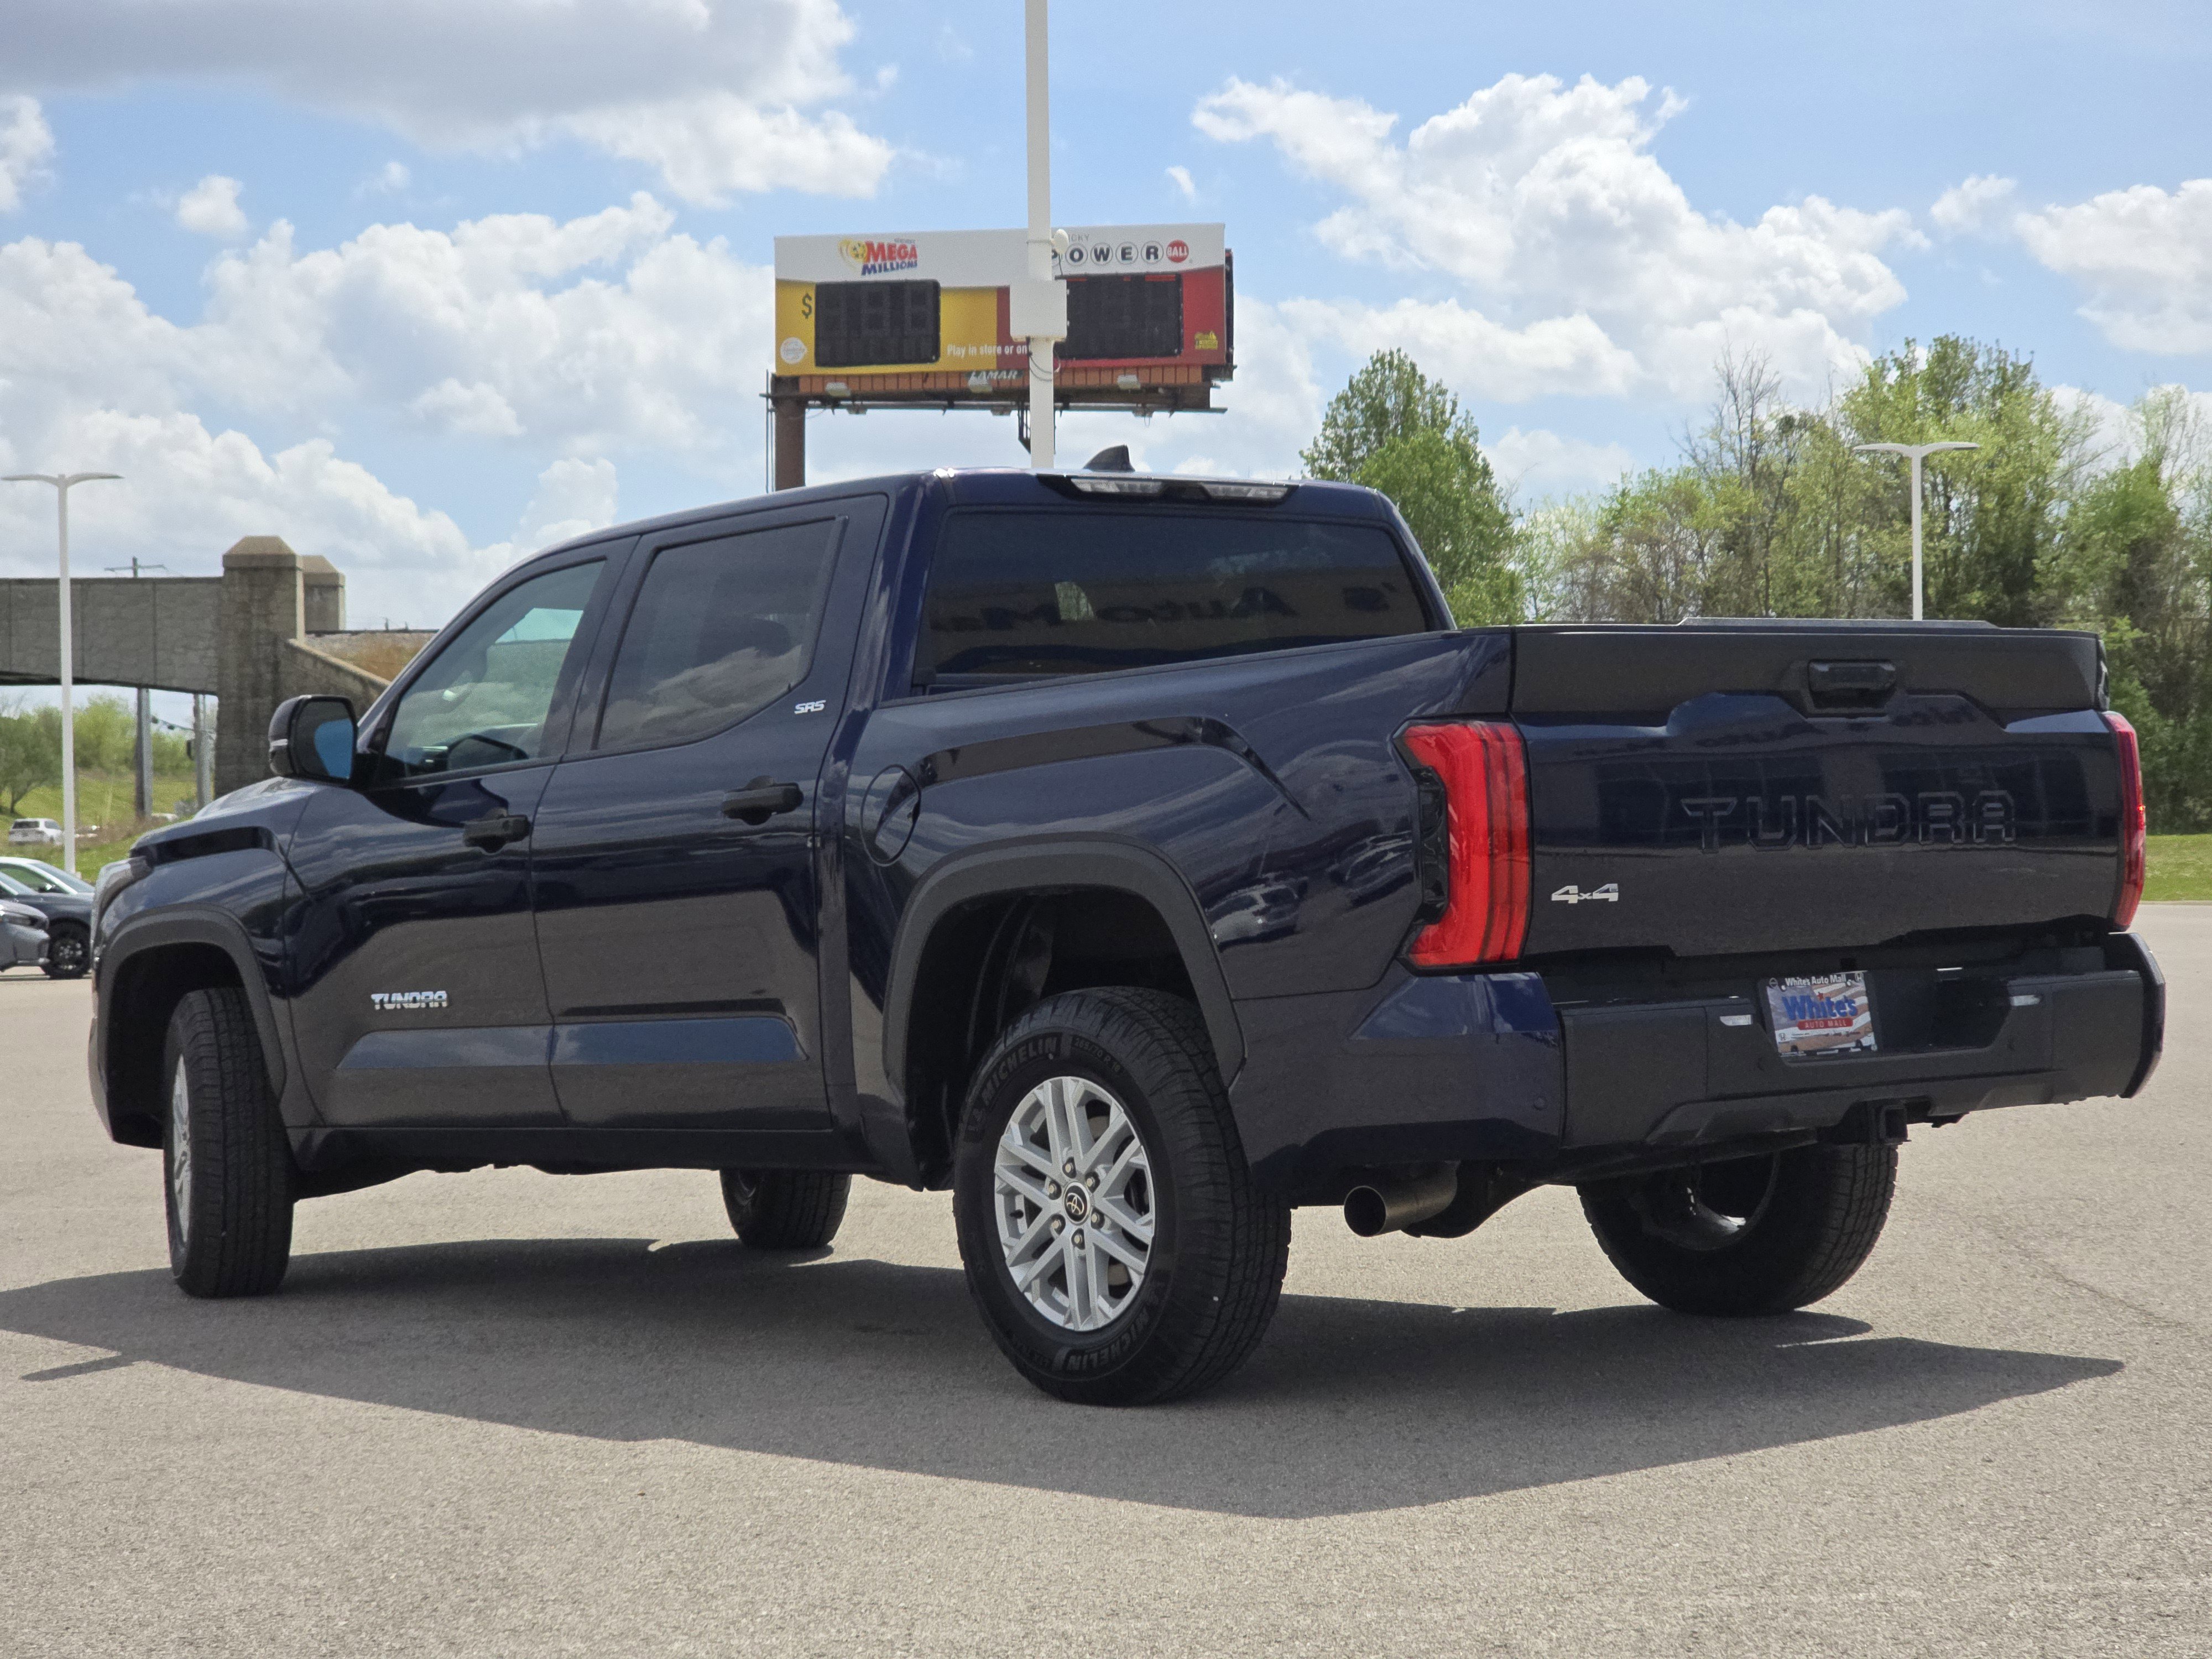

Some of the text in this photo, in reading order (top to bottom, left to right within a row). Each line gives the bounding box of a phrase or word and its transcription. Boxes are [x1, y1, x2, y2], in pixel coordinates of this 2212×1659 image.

[863, 240, 918, 263] MEGA
[860, 260, 918, 276] MILLIONS
[801, 293, 812, 319] $
[946, 343, 966, 359] Play
[968, 343, 977, 356] in
[979, 344, 1002, 356] store
[1004, 345, 1014, 354] or
[794, 700, 826, 714] SR5
[1680, 790, 2016, 854] TUNDRA
[1551, 883, 1619, 904] 4x4
[1812, 976, 1829, 985] Auto
[1829, 974, 1846, 984] Mall
[371, 990, 448, 1010] TUNDRA
[1781, 995, 1859, 1021] White's
[1805, 1019, 1847, 1029] AUTO MALL
[980, 1036, 1057, 1106] MICHELIN
[1066, 1307, 1150, 1371] MICHELIN
